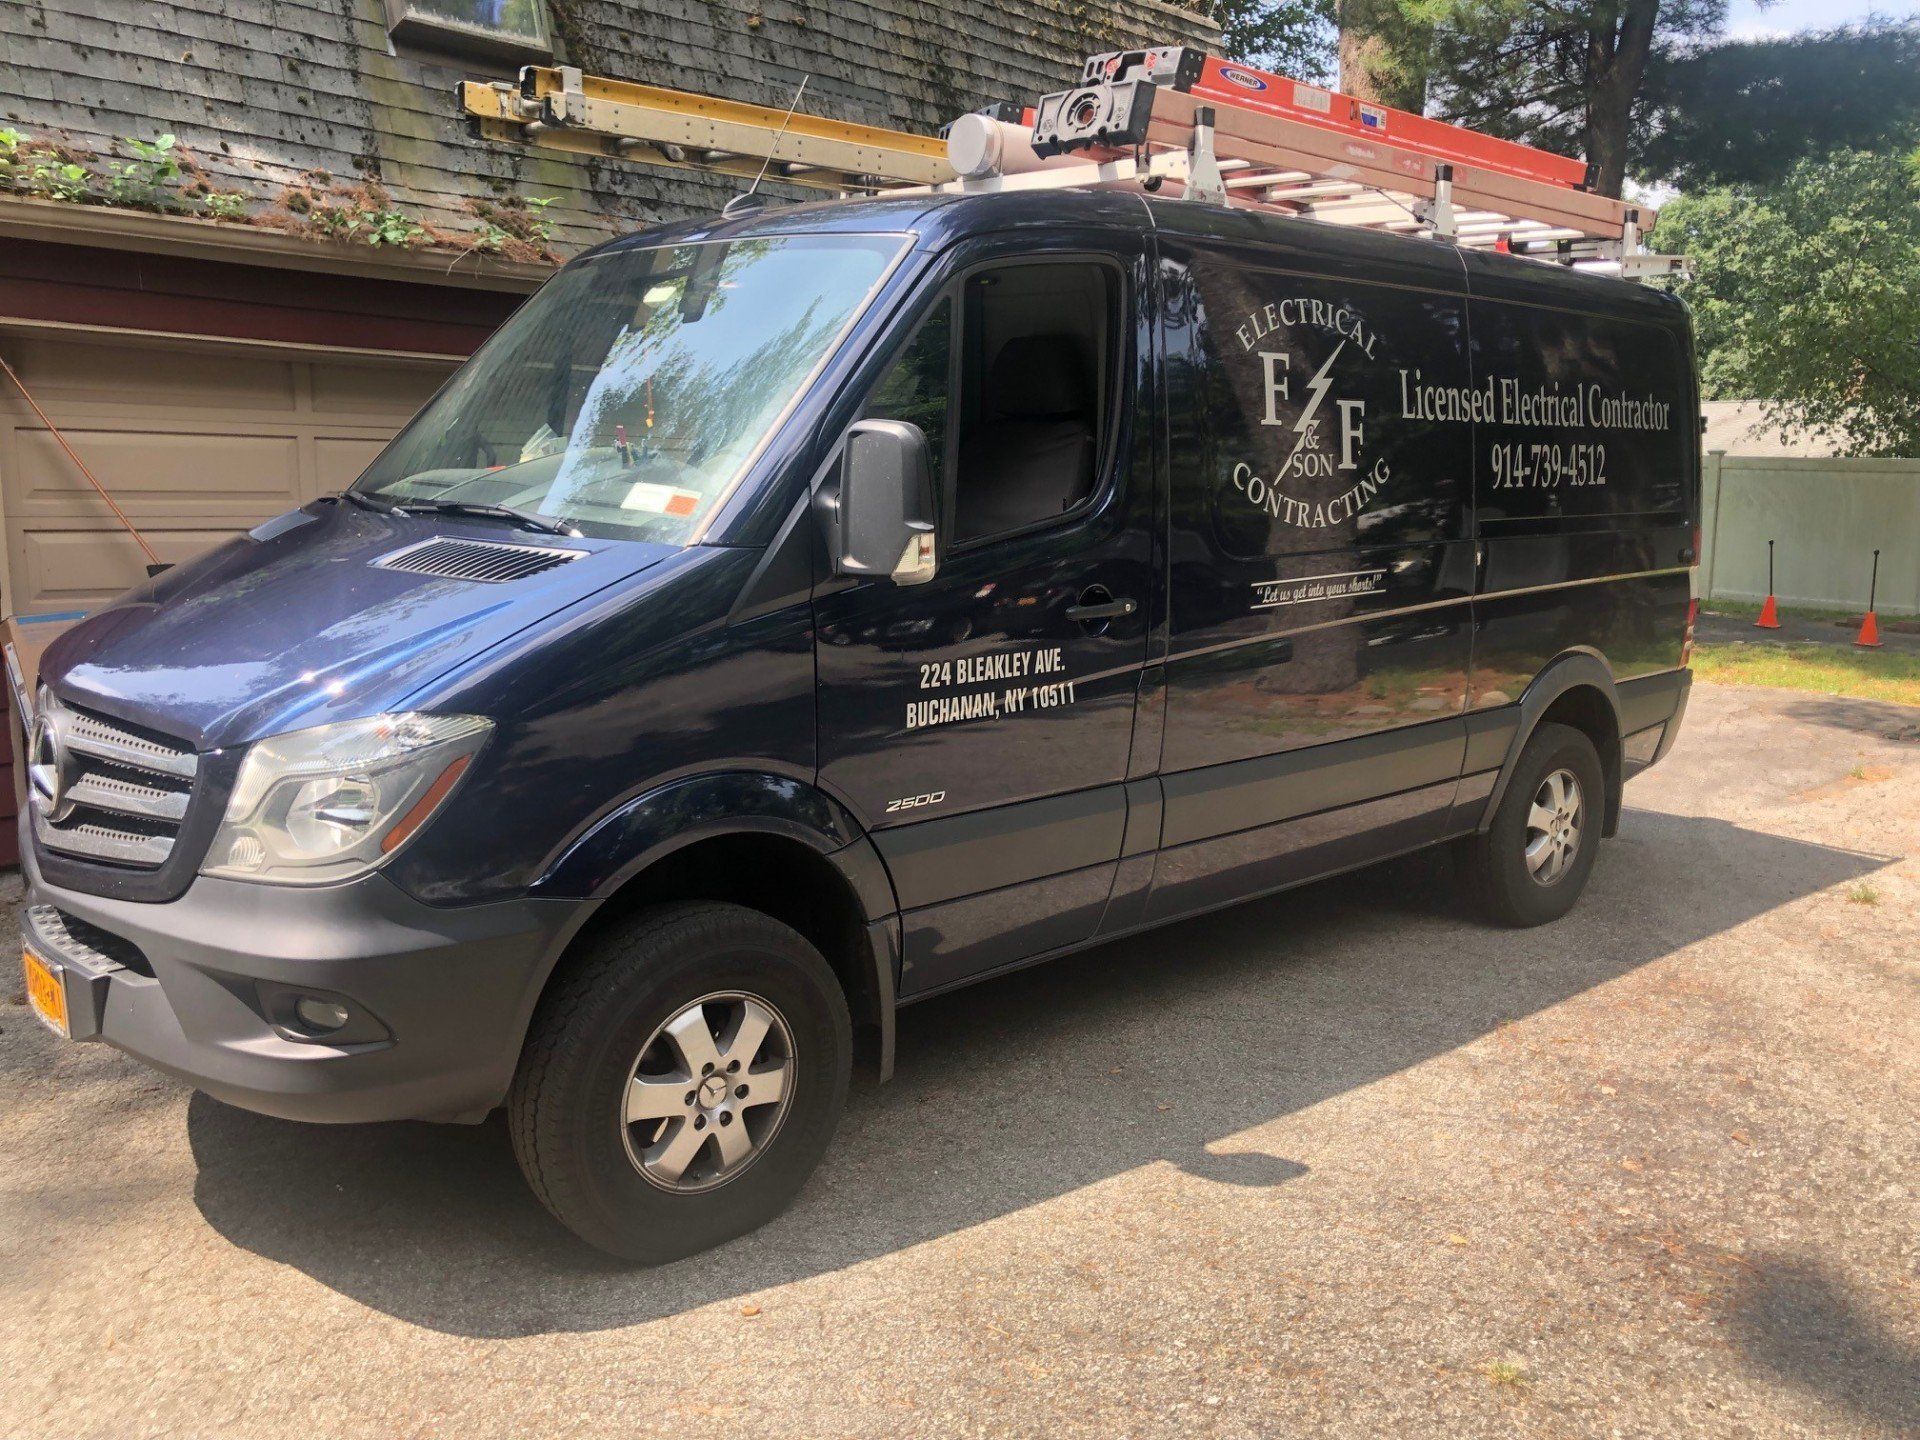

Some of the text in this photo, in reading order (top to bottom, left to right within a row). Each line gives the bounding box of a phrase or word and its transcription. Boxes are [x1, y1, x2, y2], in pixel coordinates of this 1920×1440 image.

[1229, 72, 1258, 87] WERNER
[1236, 299, 1377, 361] ELECTRICAL
[1258, 351, 1290, 426] F
[1399, 369, 1670, 431] Licensed Electrical Contractor
[1305, 424, 1320, 450] &
[1336, 399, 1365, 469] F
[1292, 453, 1334, 478] SON
[1491, 443, 1606, 489] 914-739-4512
[1233, 457, 1391, 529] CONTRACTING
[1280, 591, 1291, 602] us
[1293, 584, 1307, 605] get
[1308, 582, 1324, 598] into
[1326, 585, 1347, 600] your
[920, 647, 1066, 689] 224 BLEAKLEY AVE.
[906, 681, 1075, 729] BUCHANAN, NY 10511
[885, 790, 946, 813] 2500
